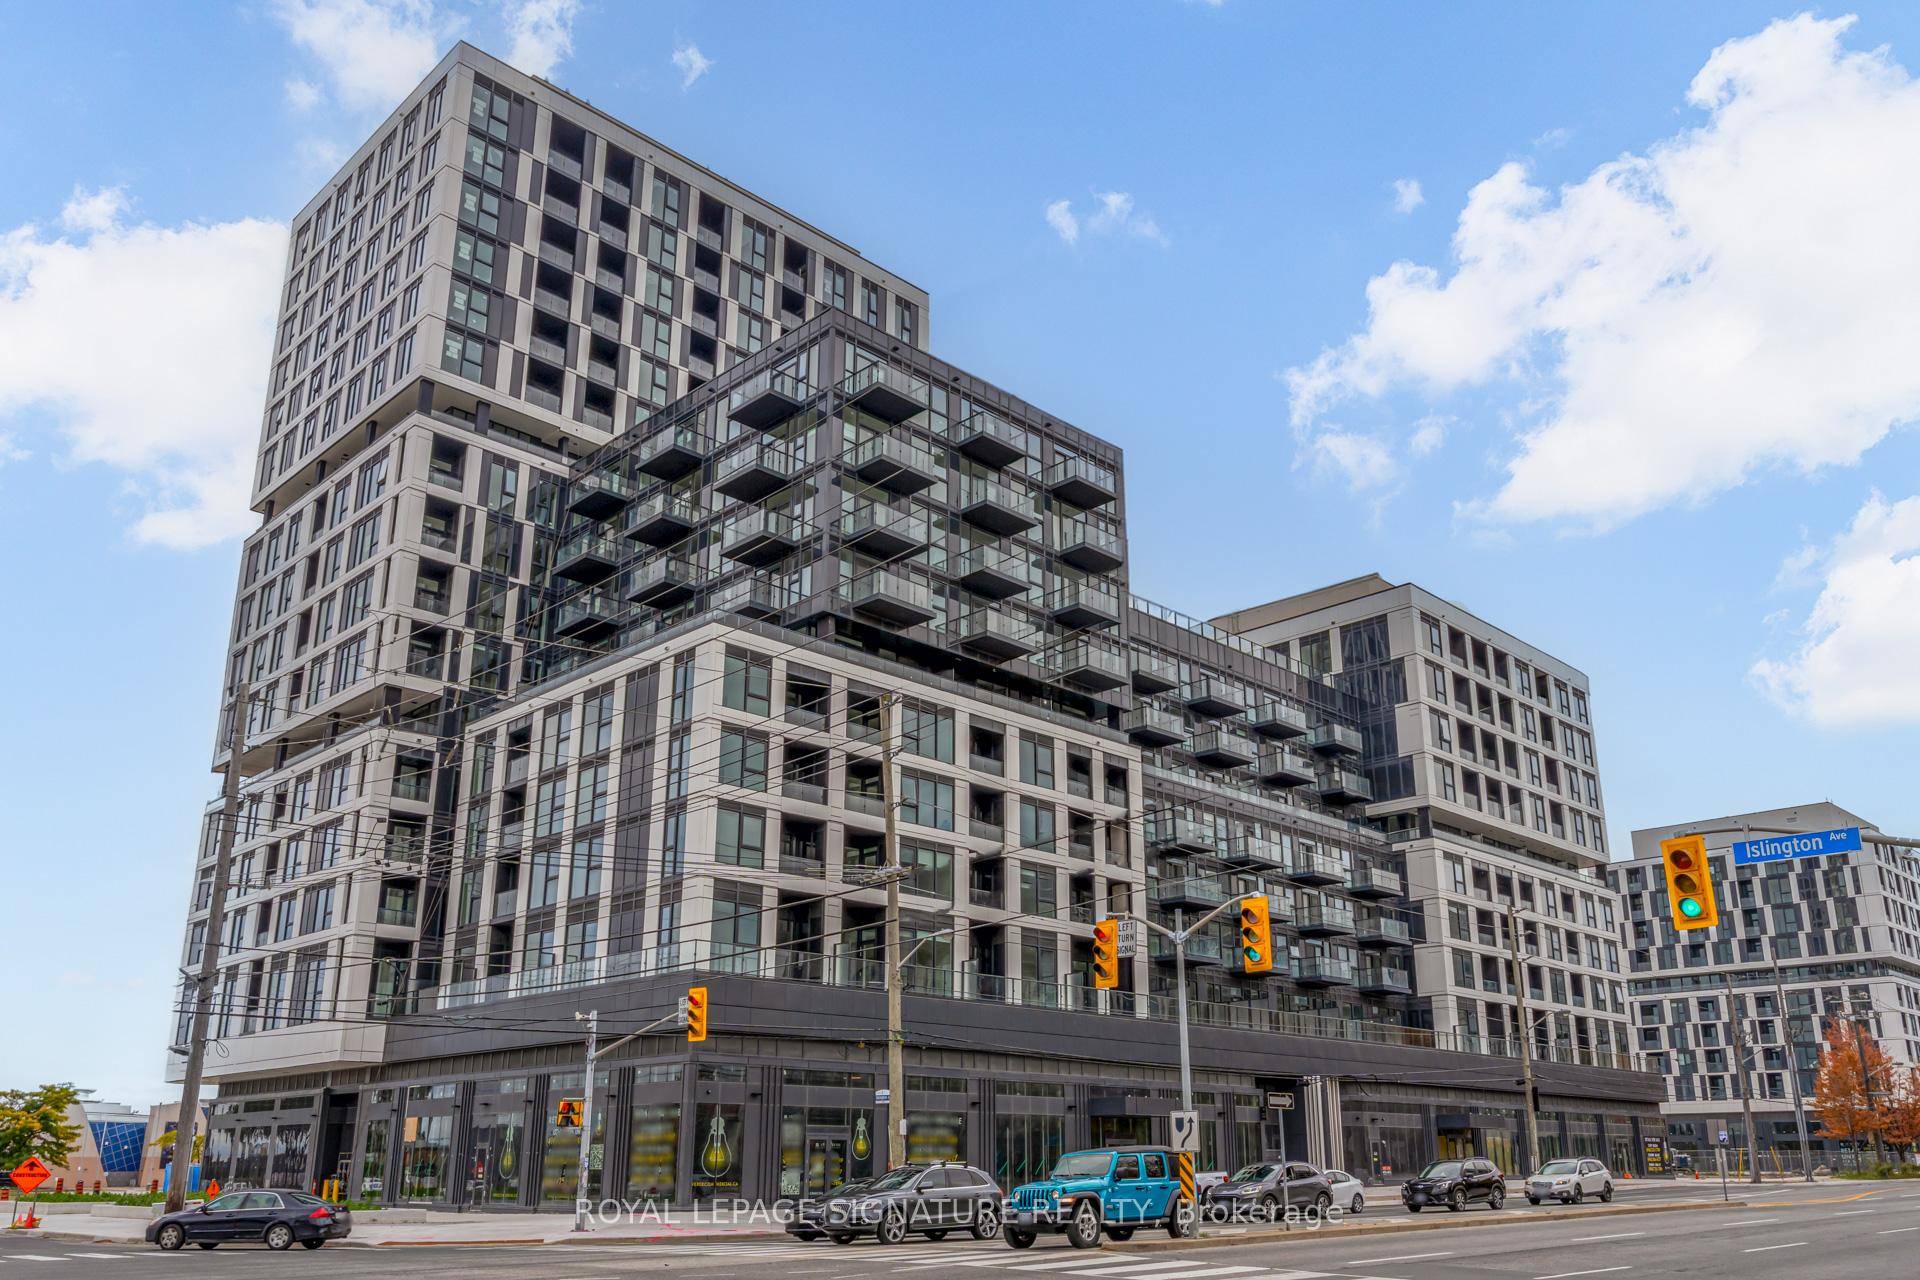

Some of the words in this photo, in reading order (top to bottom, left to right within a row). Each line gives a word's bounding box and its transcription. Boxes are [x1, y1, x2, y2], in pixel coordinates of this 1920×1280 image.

[1745, 837, 1824, 858] Islington
[1829, 832, 1847, 841] Ave
[1118, 921, 1134, 932] LEFT
[1118, 933, 1135, 943] TURN
